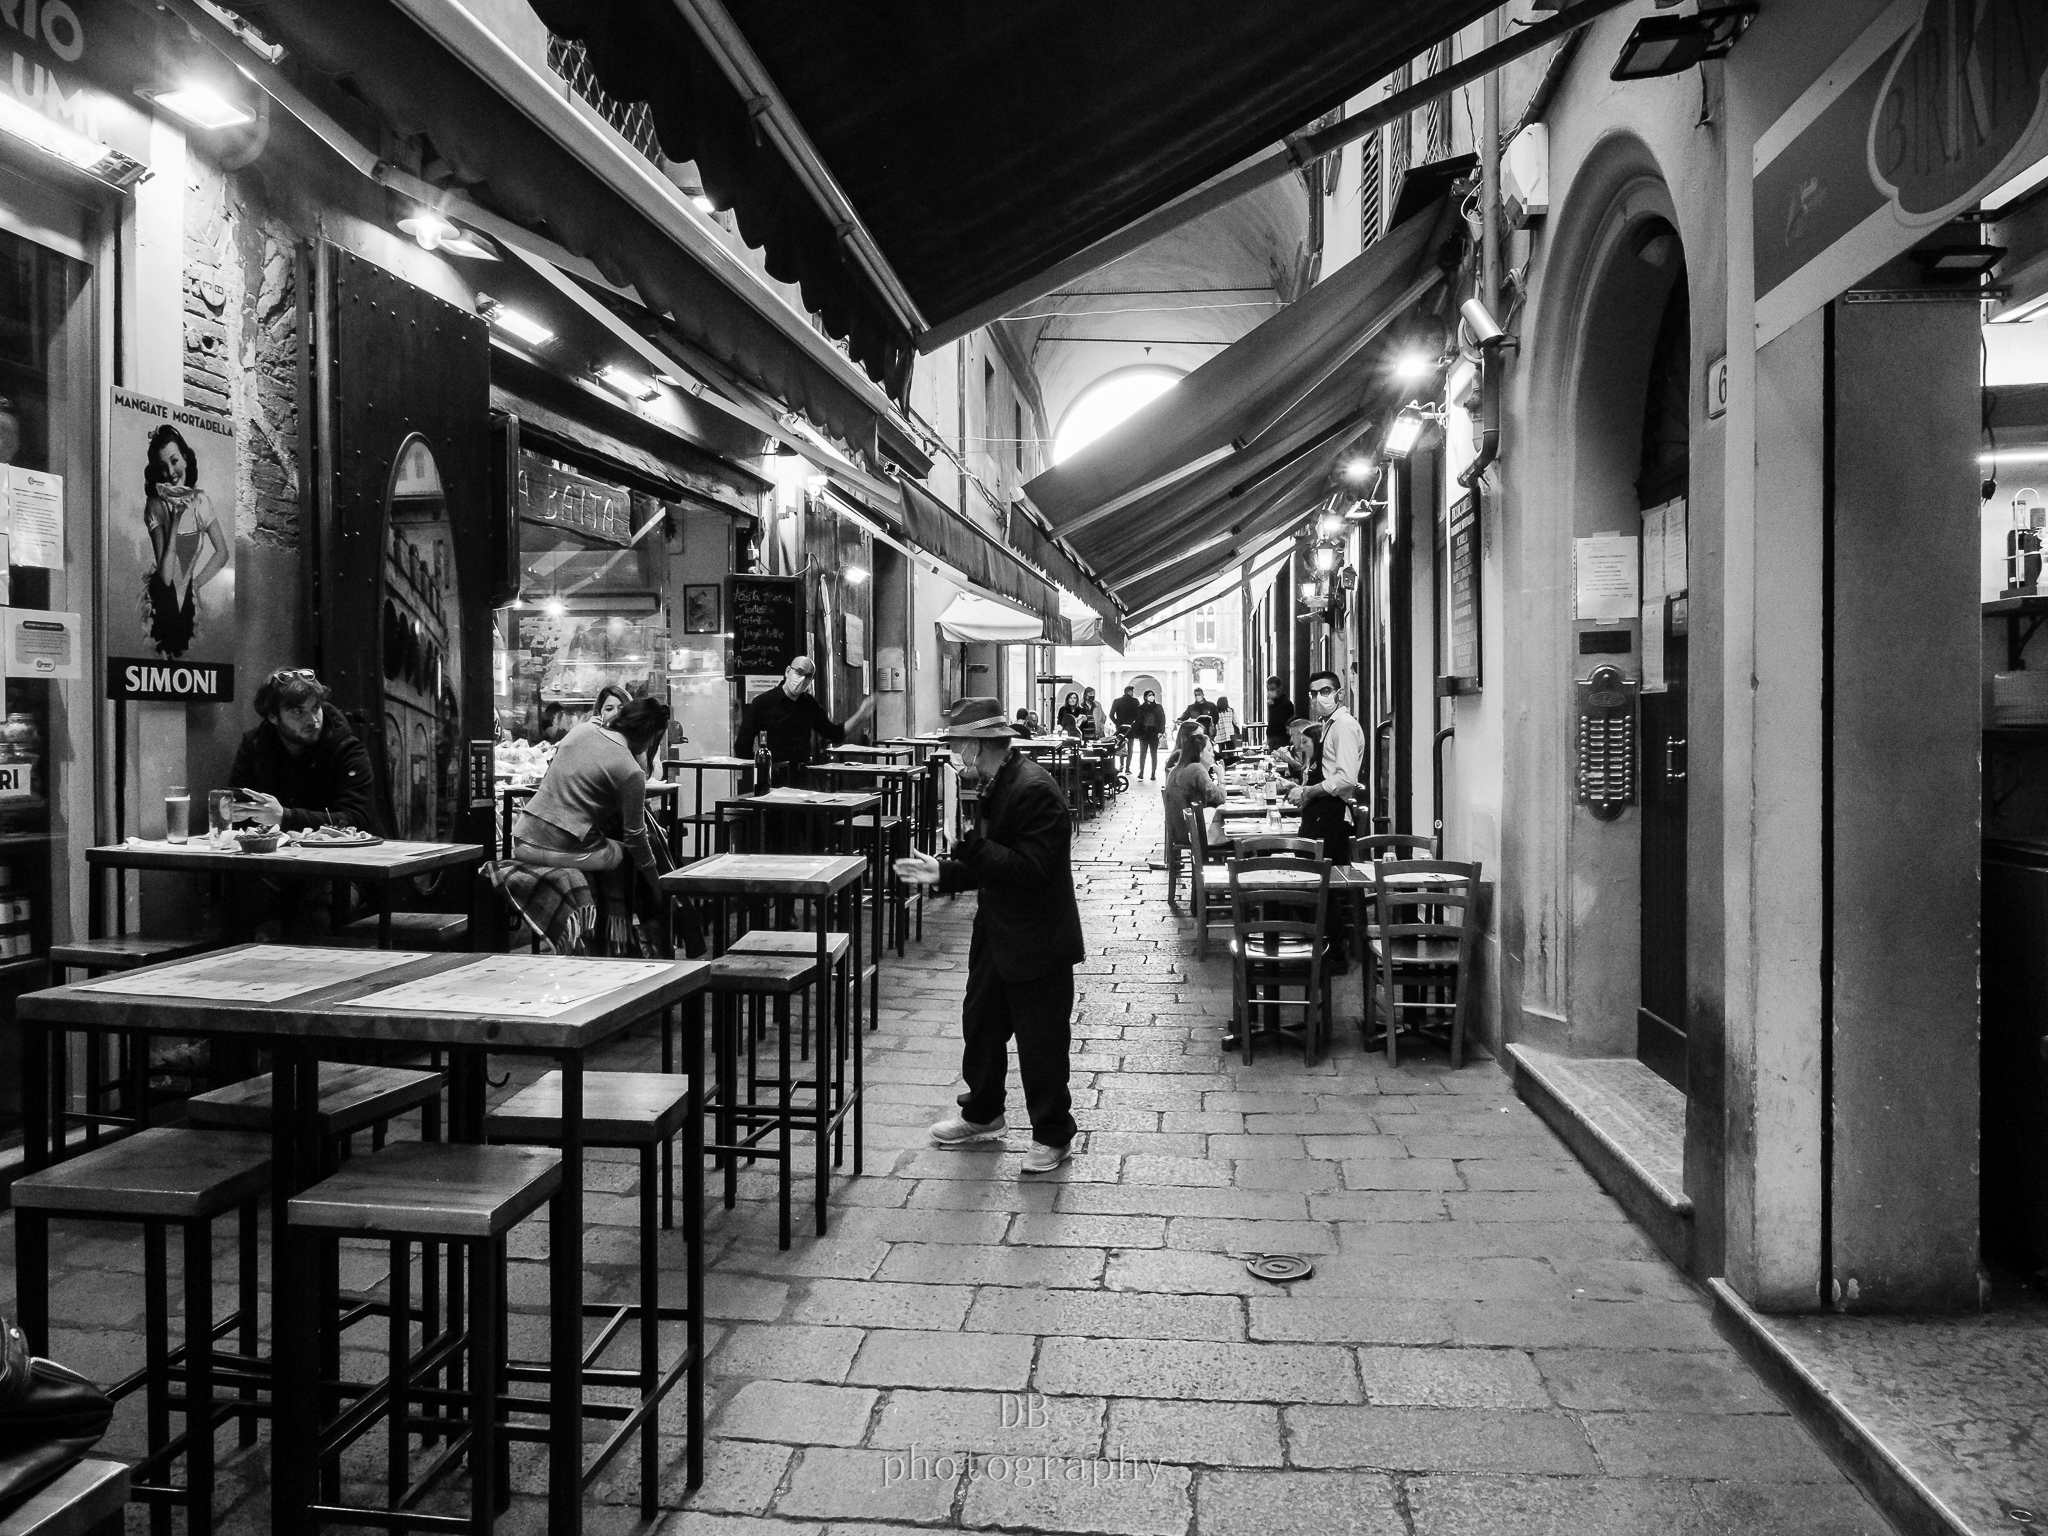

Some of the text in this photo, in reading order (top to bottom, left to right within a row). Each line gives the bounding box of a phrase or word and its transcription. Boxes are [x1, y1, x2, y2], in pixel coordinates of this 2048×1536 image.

[1718, 364, 1728, 404] 6
[114, 393, 234, 438] MANGIATE MORTADELLA
[733, 583, 761, 603] Pasta
[125, 665, 217, 694] SIMONI
